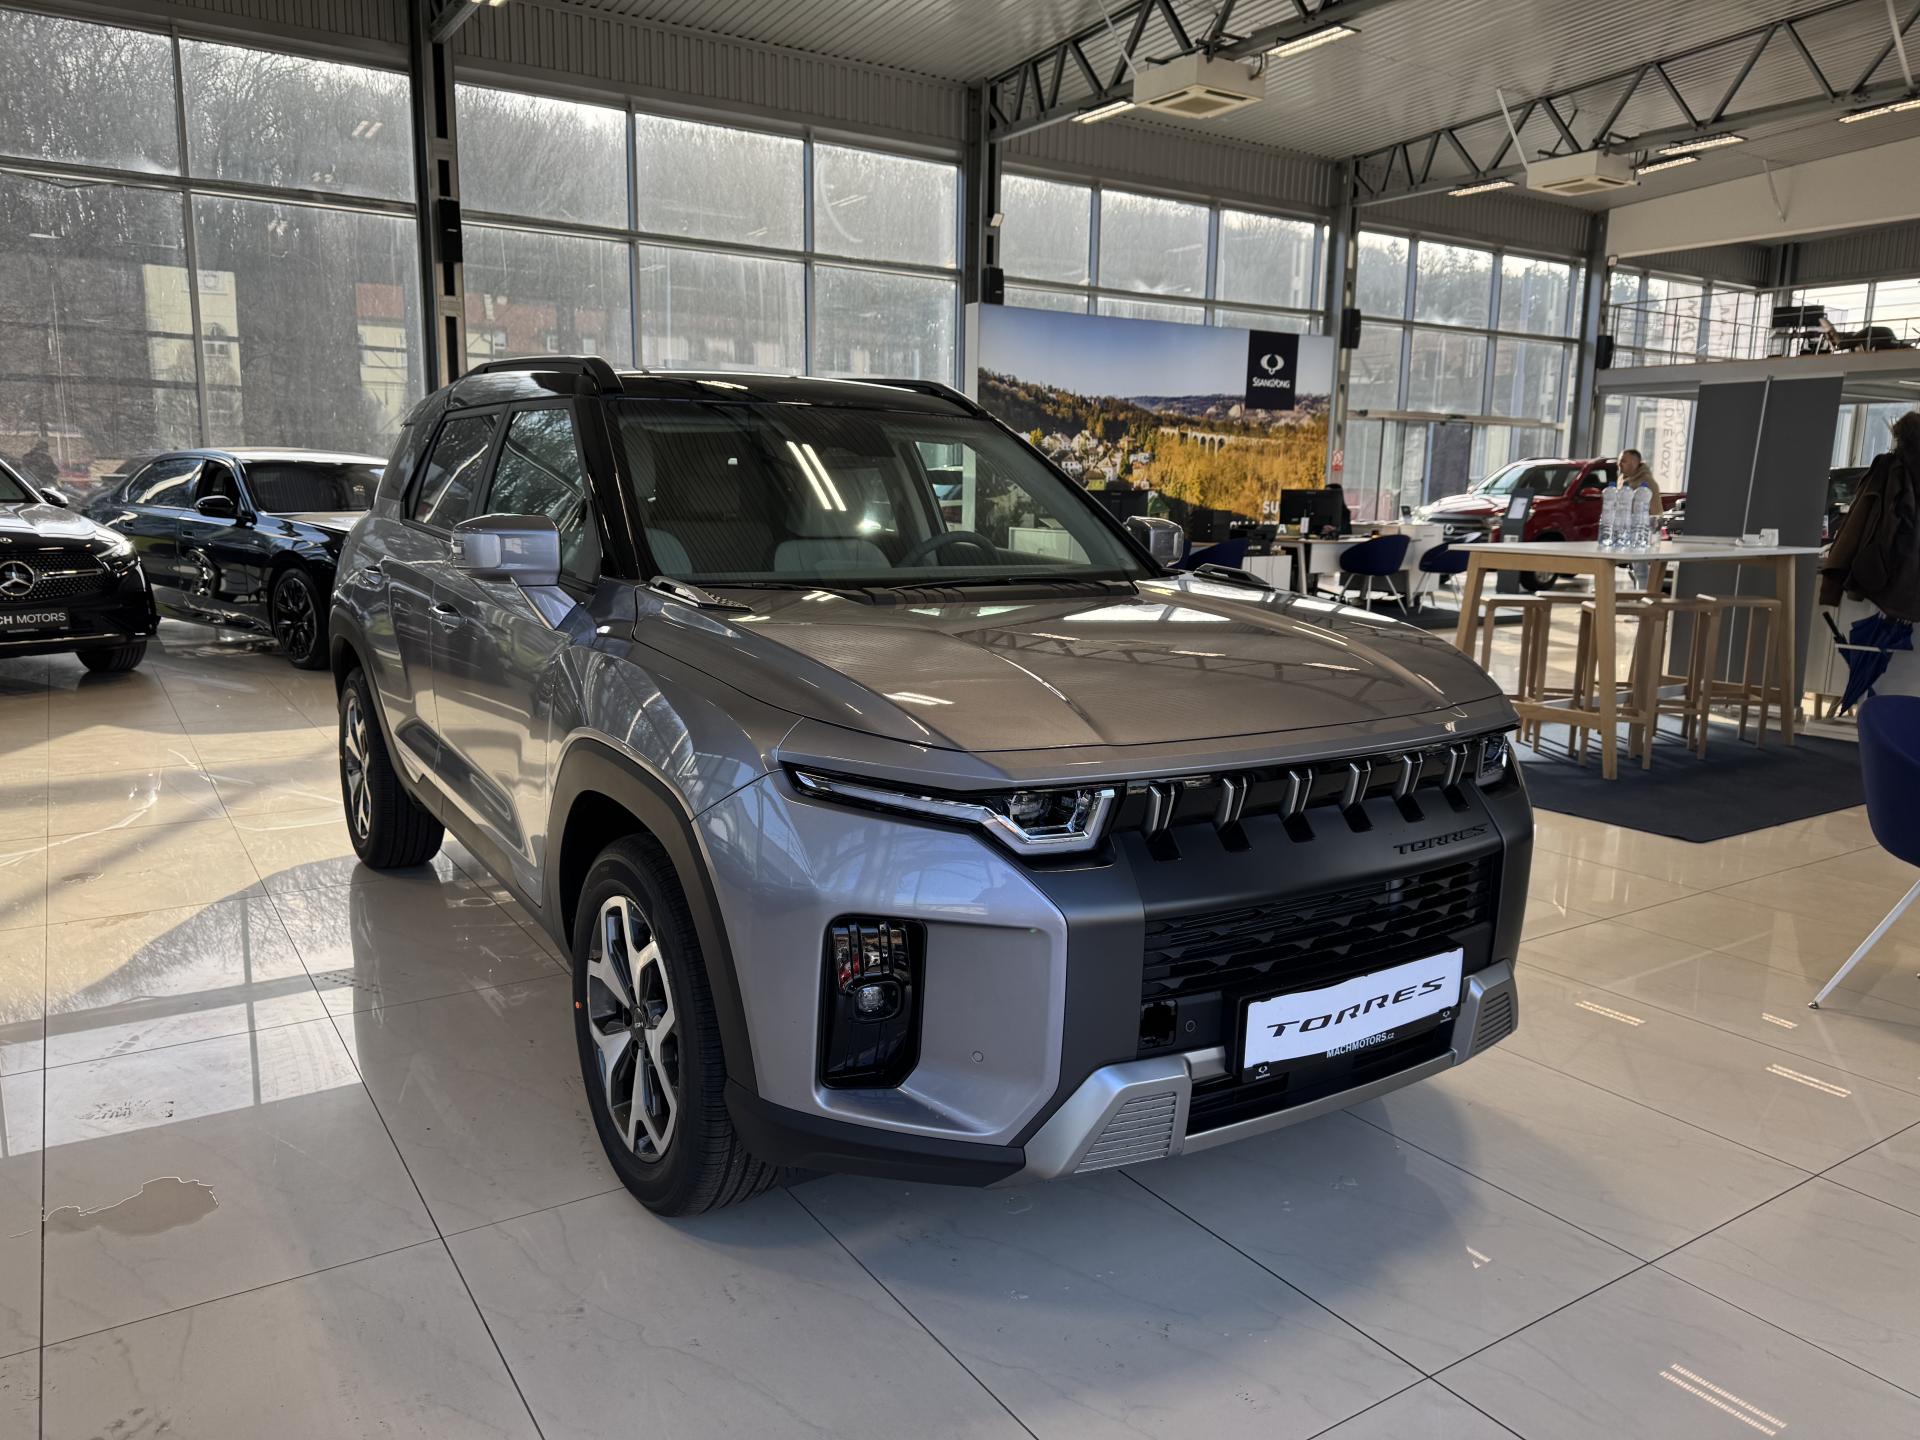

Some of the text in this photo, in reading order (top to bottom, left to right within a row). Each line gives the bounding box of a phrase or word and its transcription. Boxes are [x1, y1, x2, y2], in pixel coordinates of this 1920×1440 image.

[16, 612, 67, 624] MOTORS
[1393, 823, 1488, 855] TORRES
[1267, 976, 1446, 1038] TORRES
